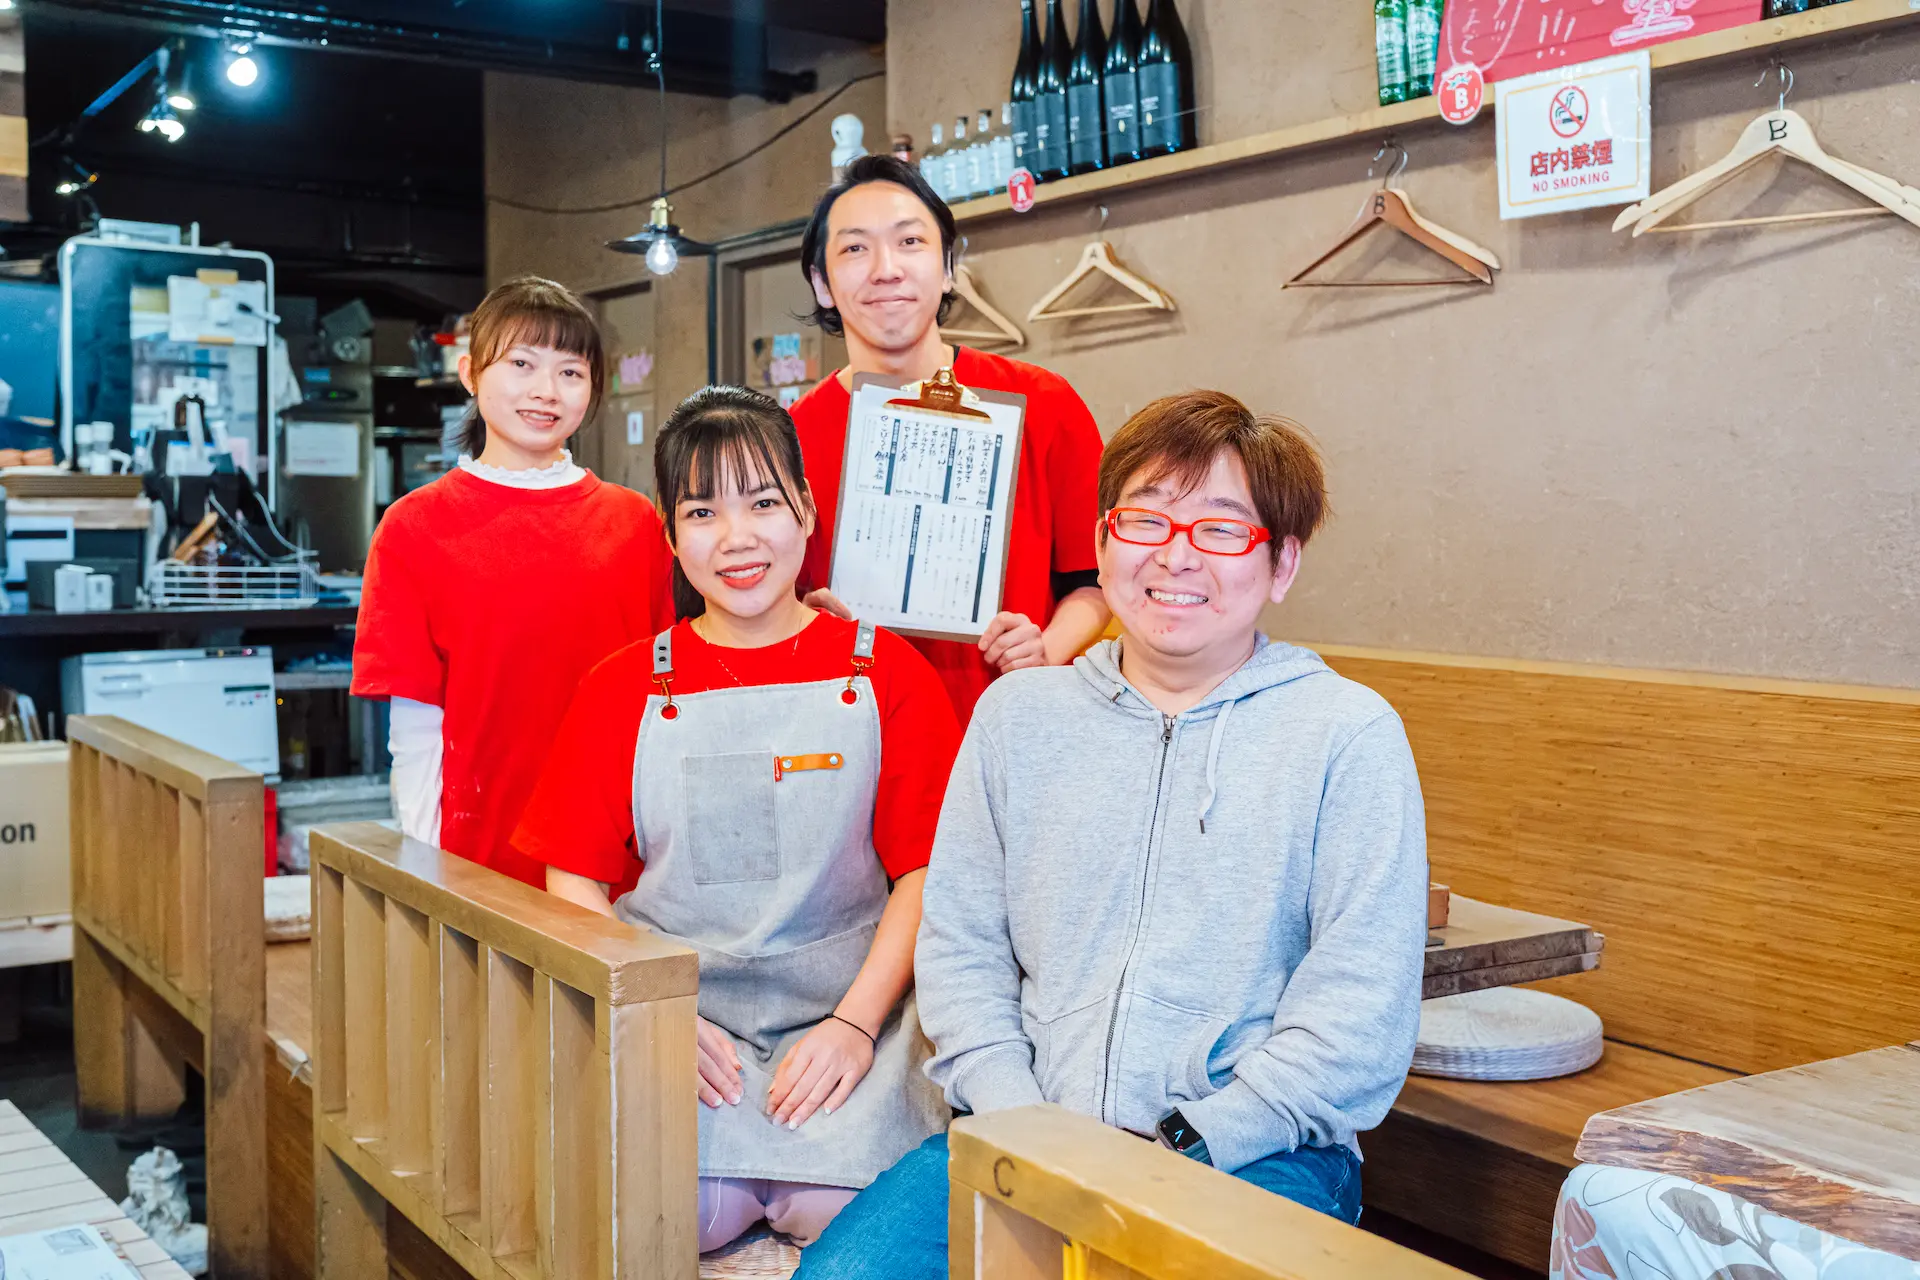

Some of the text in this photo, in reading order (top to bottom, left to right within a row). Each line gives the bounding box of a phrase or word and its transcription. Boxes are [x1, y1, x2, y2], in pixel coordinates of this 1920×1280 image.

[1455, 87, 1469, 110] B
[1768, 118, 1788, 142] B
[1530, 138, 1613, 177] 店内禁煙
[1532, 170, 1609, 193] NO SMOKING
[1373, 194, 1386, 216] B
[993, 1155, 1015, 1198] C
